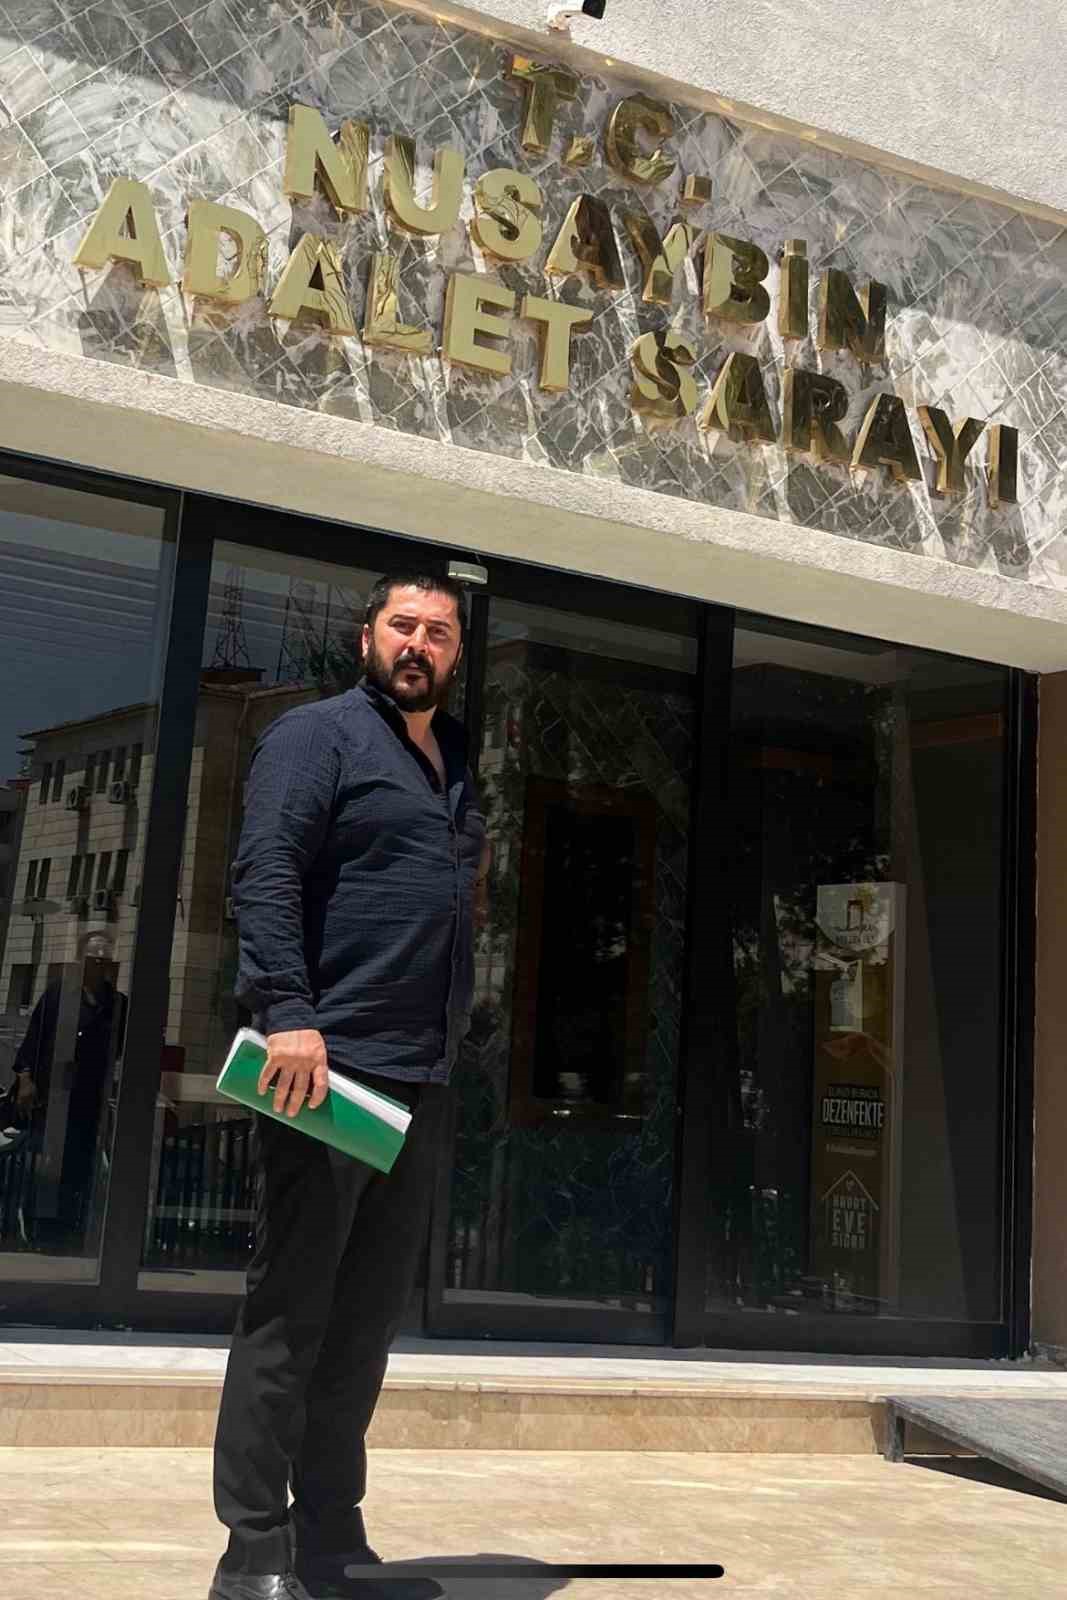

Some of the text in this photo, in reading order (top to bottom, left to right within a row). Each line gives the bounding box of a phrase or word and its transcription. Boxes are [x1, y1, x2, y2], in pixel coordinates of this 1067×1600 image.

[74, 176, 1018, 505] ADALET SARAYI
[823, 1098, 884, 1127] DEZENFEKTE
[832, 1209, 867, 1234] EVE
